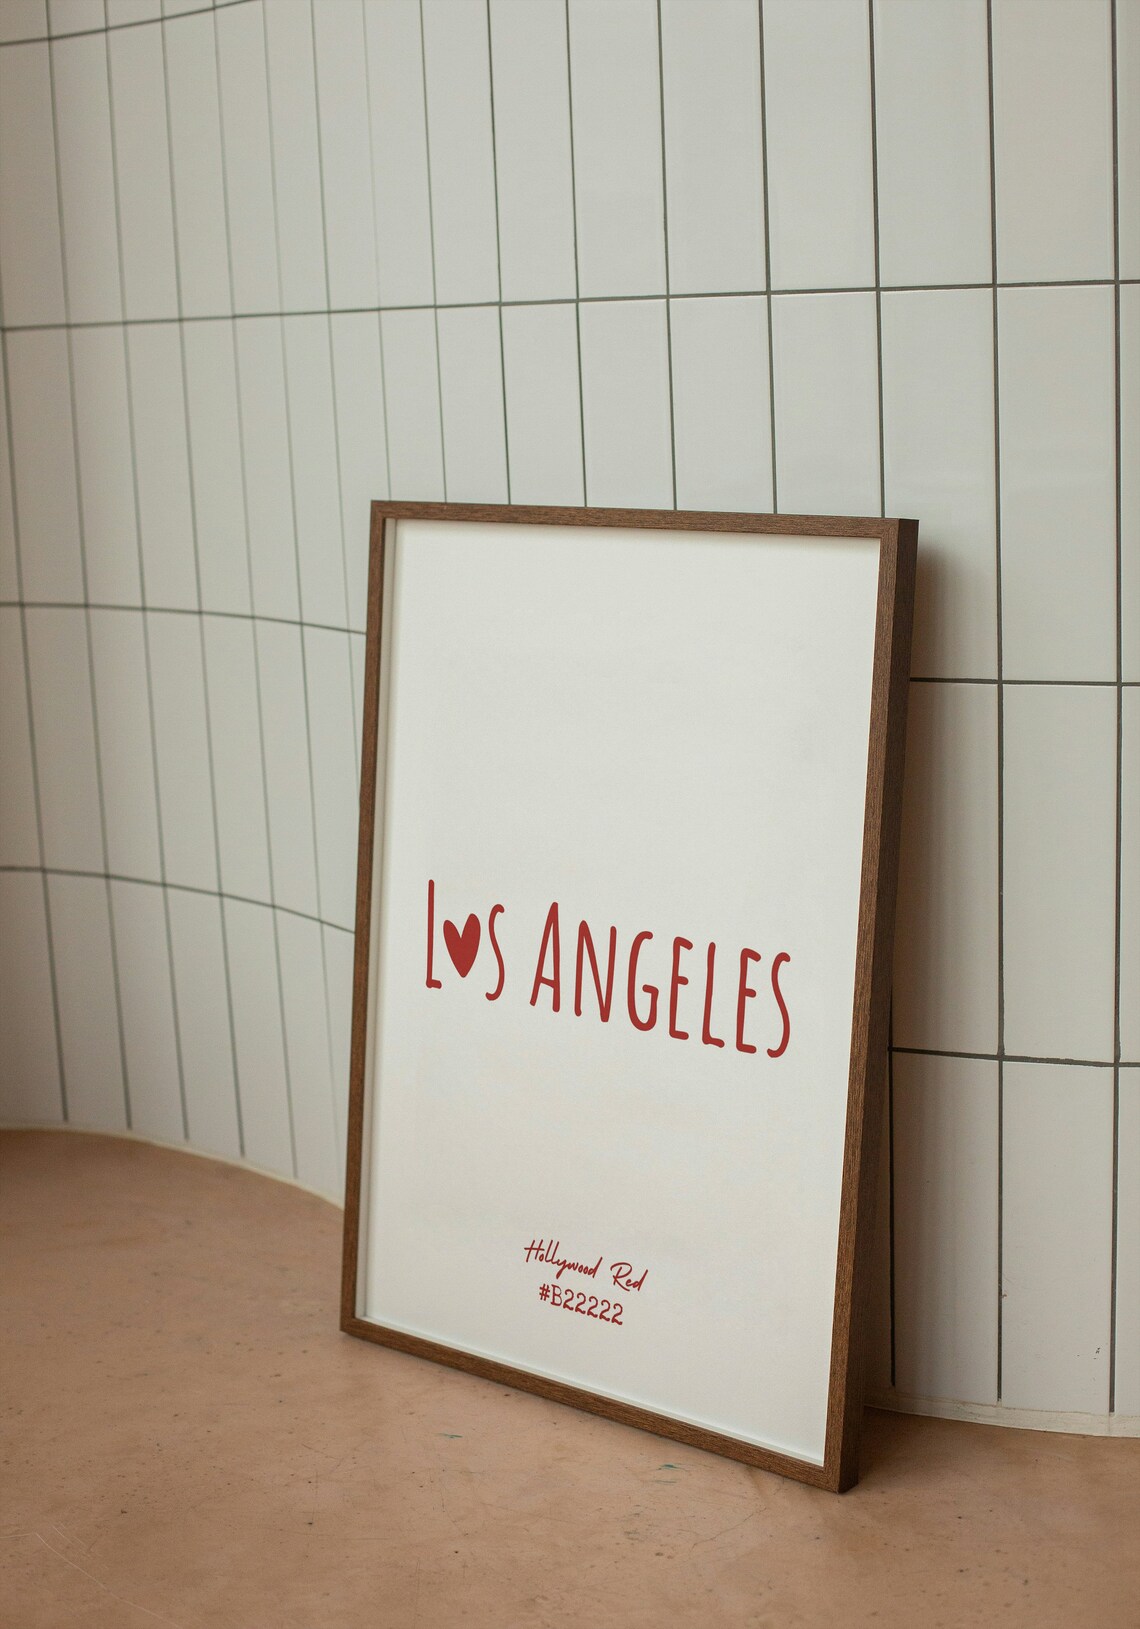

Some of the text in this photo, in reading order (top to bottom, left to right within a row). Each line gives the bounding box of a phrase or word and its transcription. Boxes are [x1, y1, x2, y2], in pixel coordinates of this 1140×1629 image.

[529, 901, 792, 1059] ANGELES
[523, 1239, 649, 1292] Hollywood Red
[539, 1283, 623, 1326] #B22222
